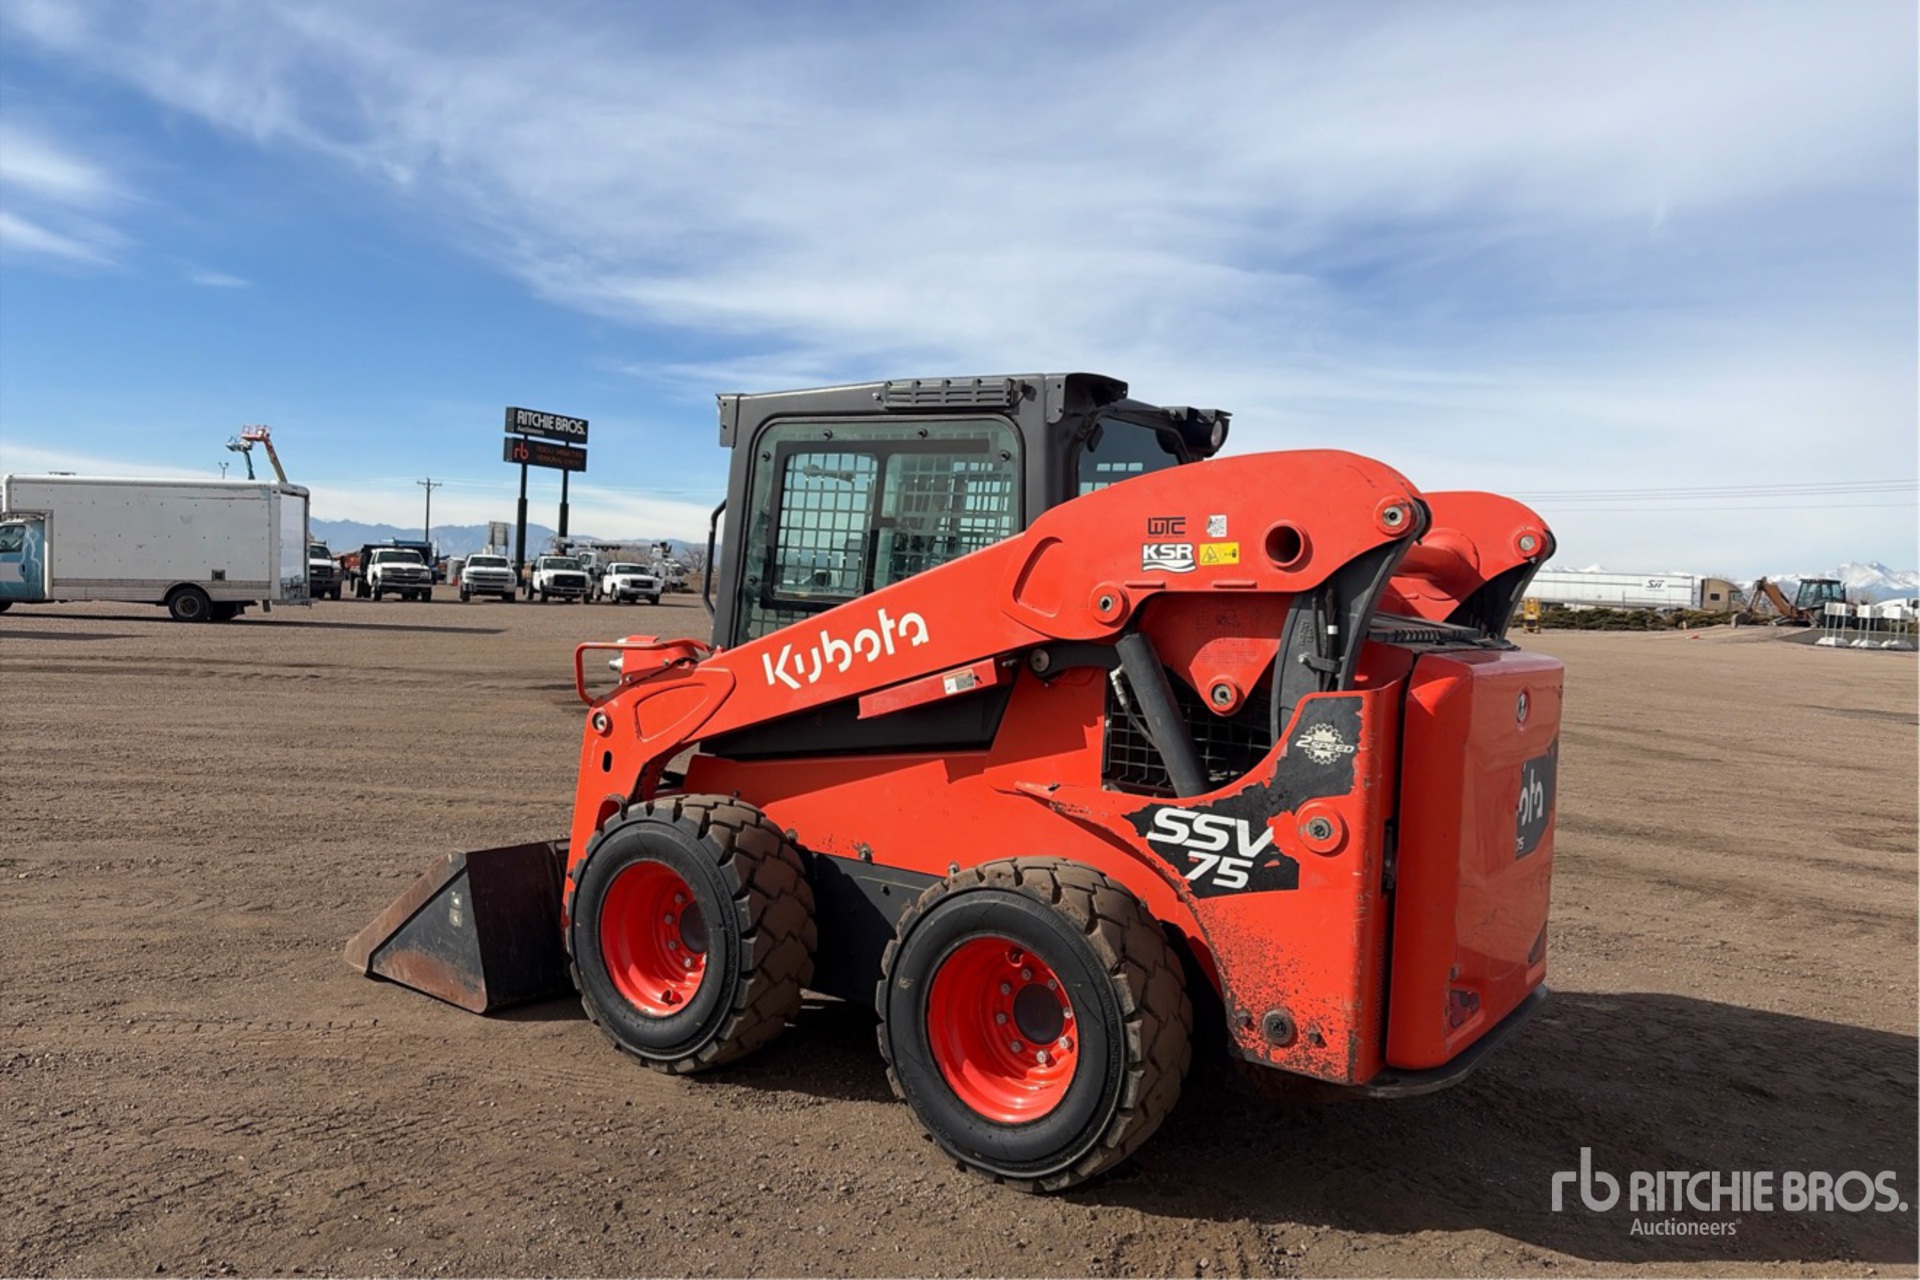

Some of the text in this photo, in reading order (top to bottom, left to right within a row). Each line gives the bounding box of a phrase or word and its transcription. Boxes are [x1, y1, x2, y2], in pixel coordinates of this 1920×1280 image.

[517, 410, 585, 435] RITCHIE BROS.
[514, 442, 529, 460] rb
[1143, 544, 1193, 560] KSR
[762, 608, 930, 690] Kubota
[1146, 807, 1274, 858] SSV
[1184, 850, 1254, 889] 75
